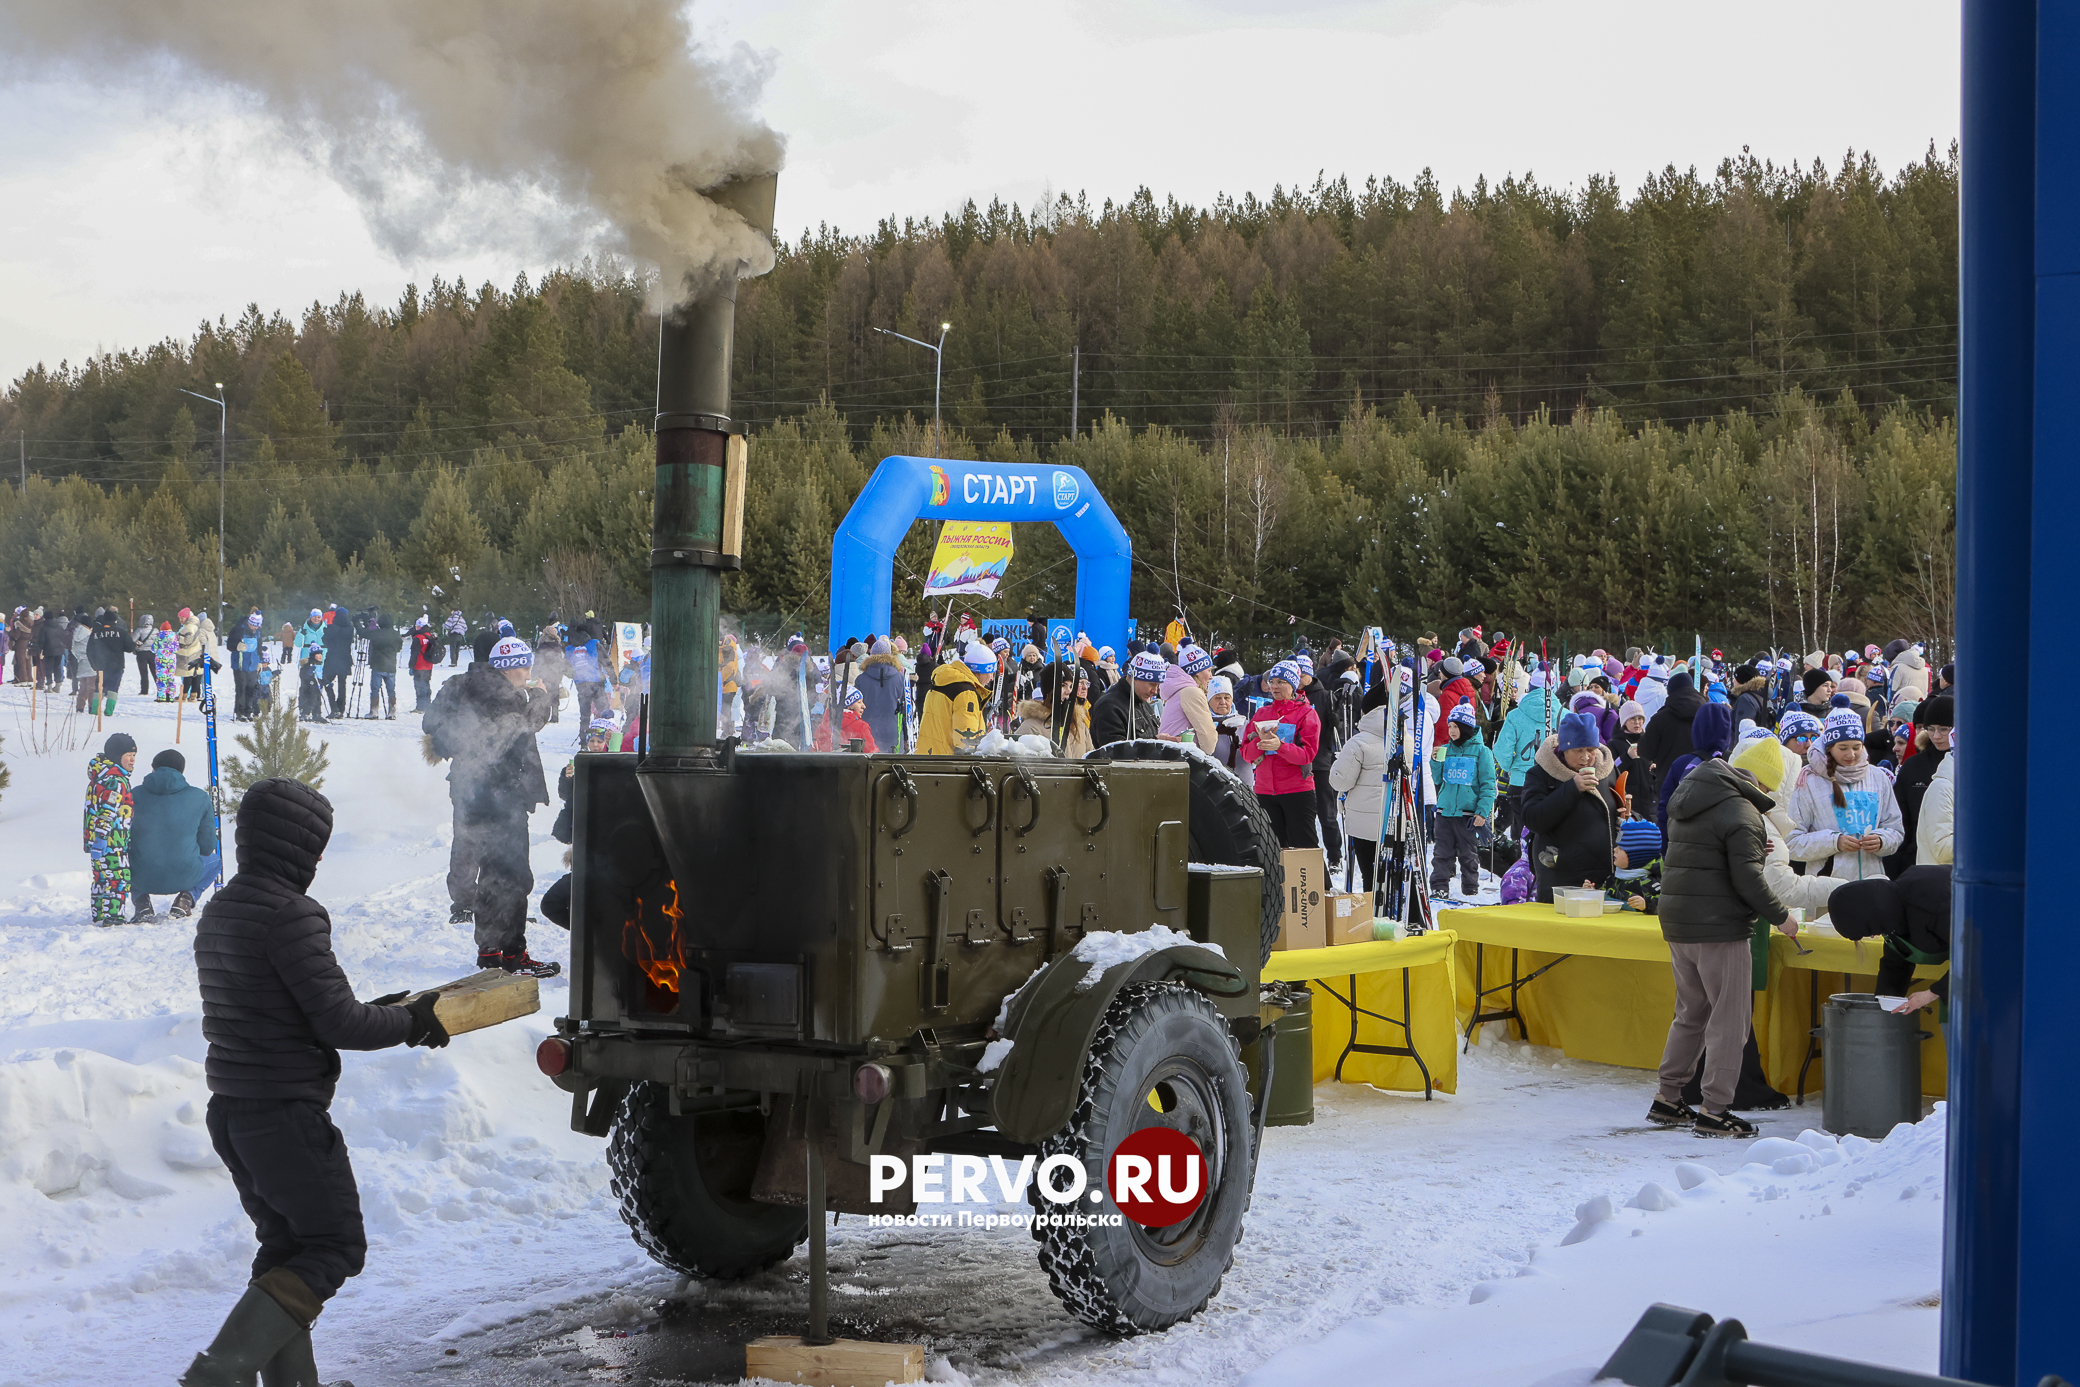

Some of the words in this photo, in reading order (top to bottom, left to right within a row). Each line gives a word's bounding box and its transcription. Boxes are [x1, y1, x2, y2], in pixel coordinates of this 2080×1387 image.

[964, 473, 1038, 504] СТАРТ
[941, 535, 972, 543] ЛЫЖНЯ
[972, 535, 1010, 548] РОССИИ
[94, 631, 120, 639] KAPPA
[494, 656, 527, 669] 2026
[1186, 658, 1210, 674] 2026
[1414, 709, 1424, 756] NORDWAY
[1447, 769, 1467, 779] 5056
[1300, 867, 1308, 929] UPAX-UNITY
